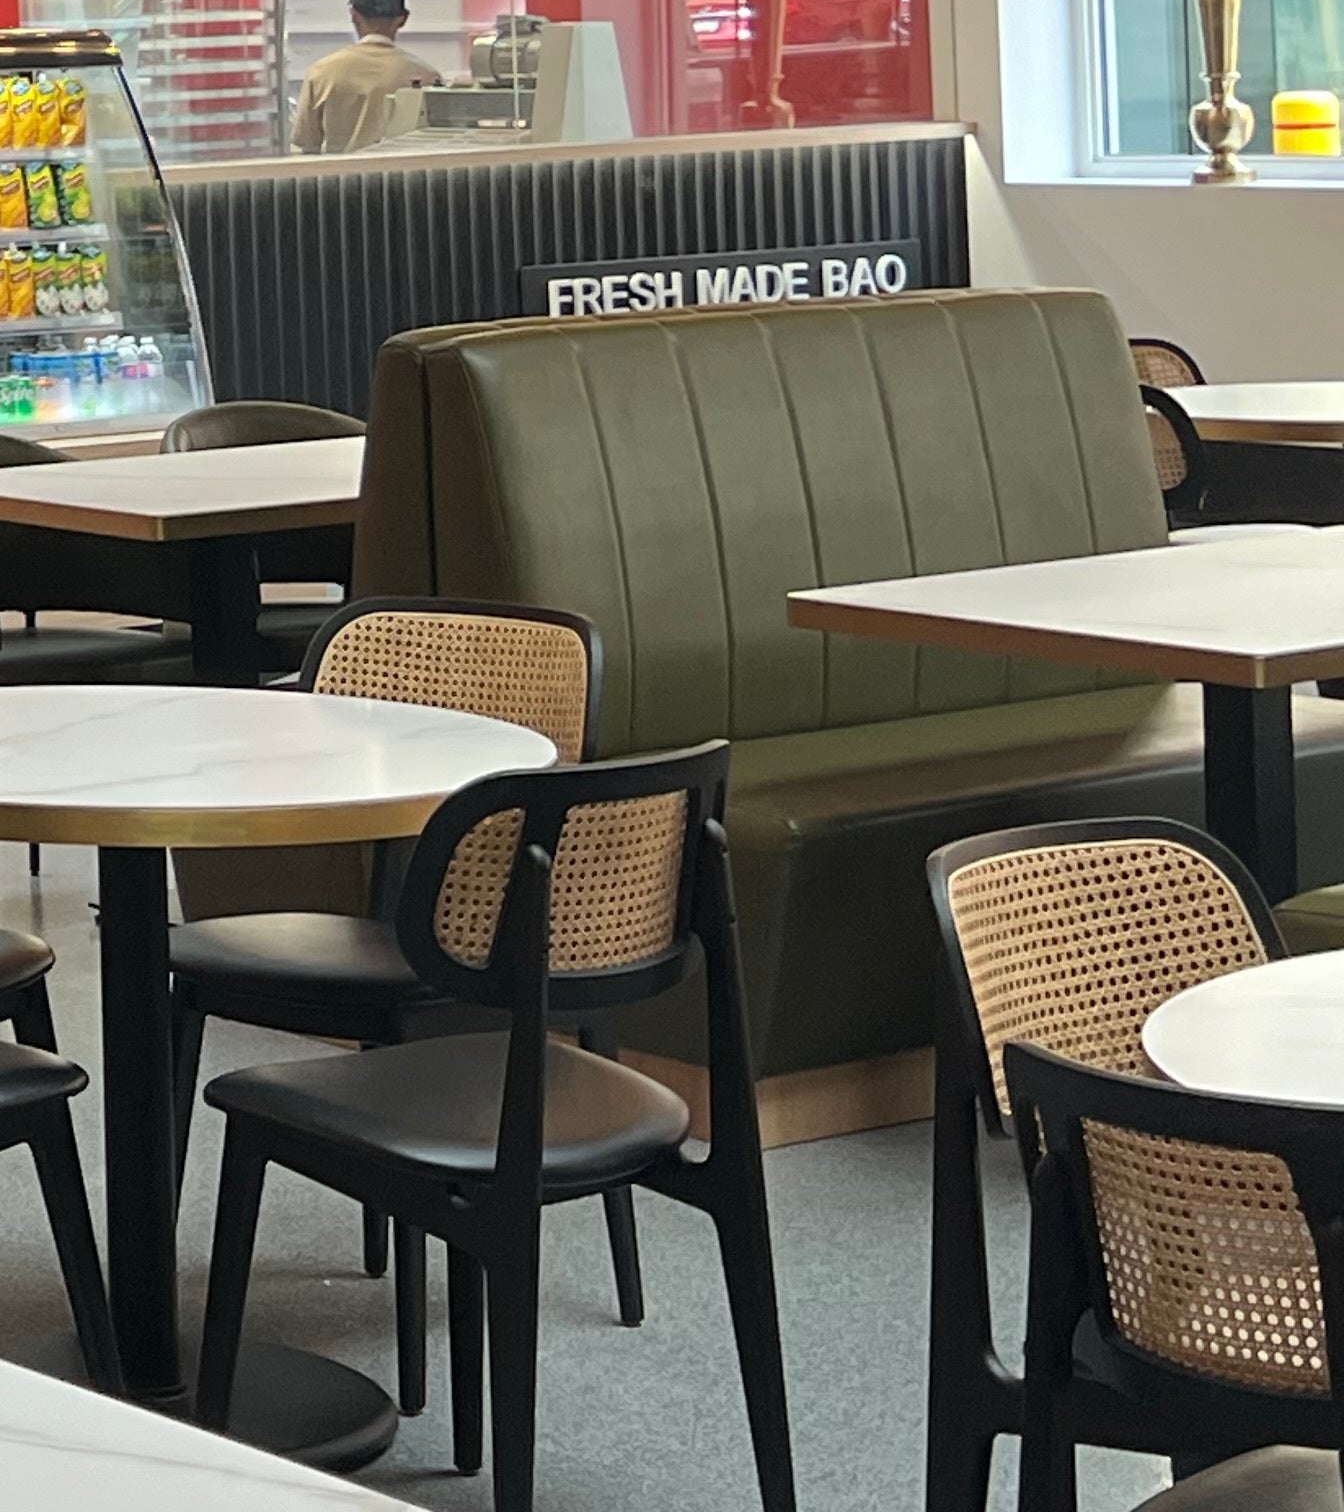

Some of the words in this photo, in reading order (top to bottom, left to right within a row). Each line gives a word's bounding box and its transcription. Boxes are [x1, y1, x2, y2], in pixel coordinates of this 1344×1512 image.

[546, 270, 684, 318] FRESH
[695, 261, 811, 305] MADE
[820, 253, 908, 300] BAO
